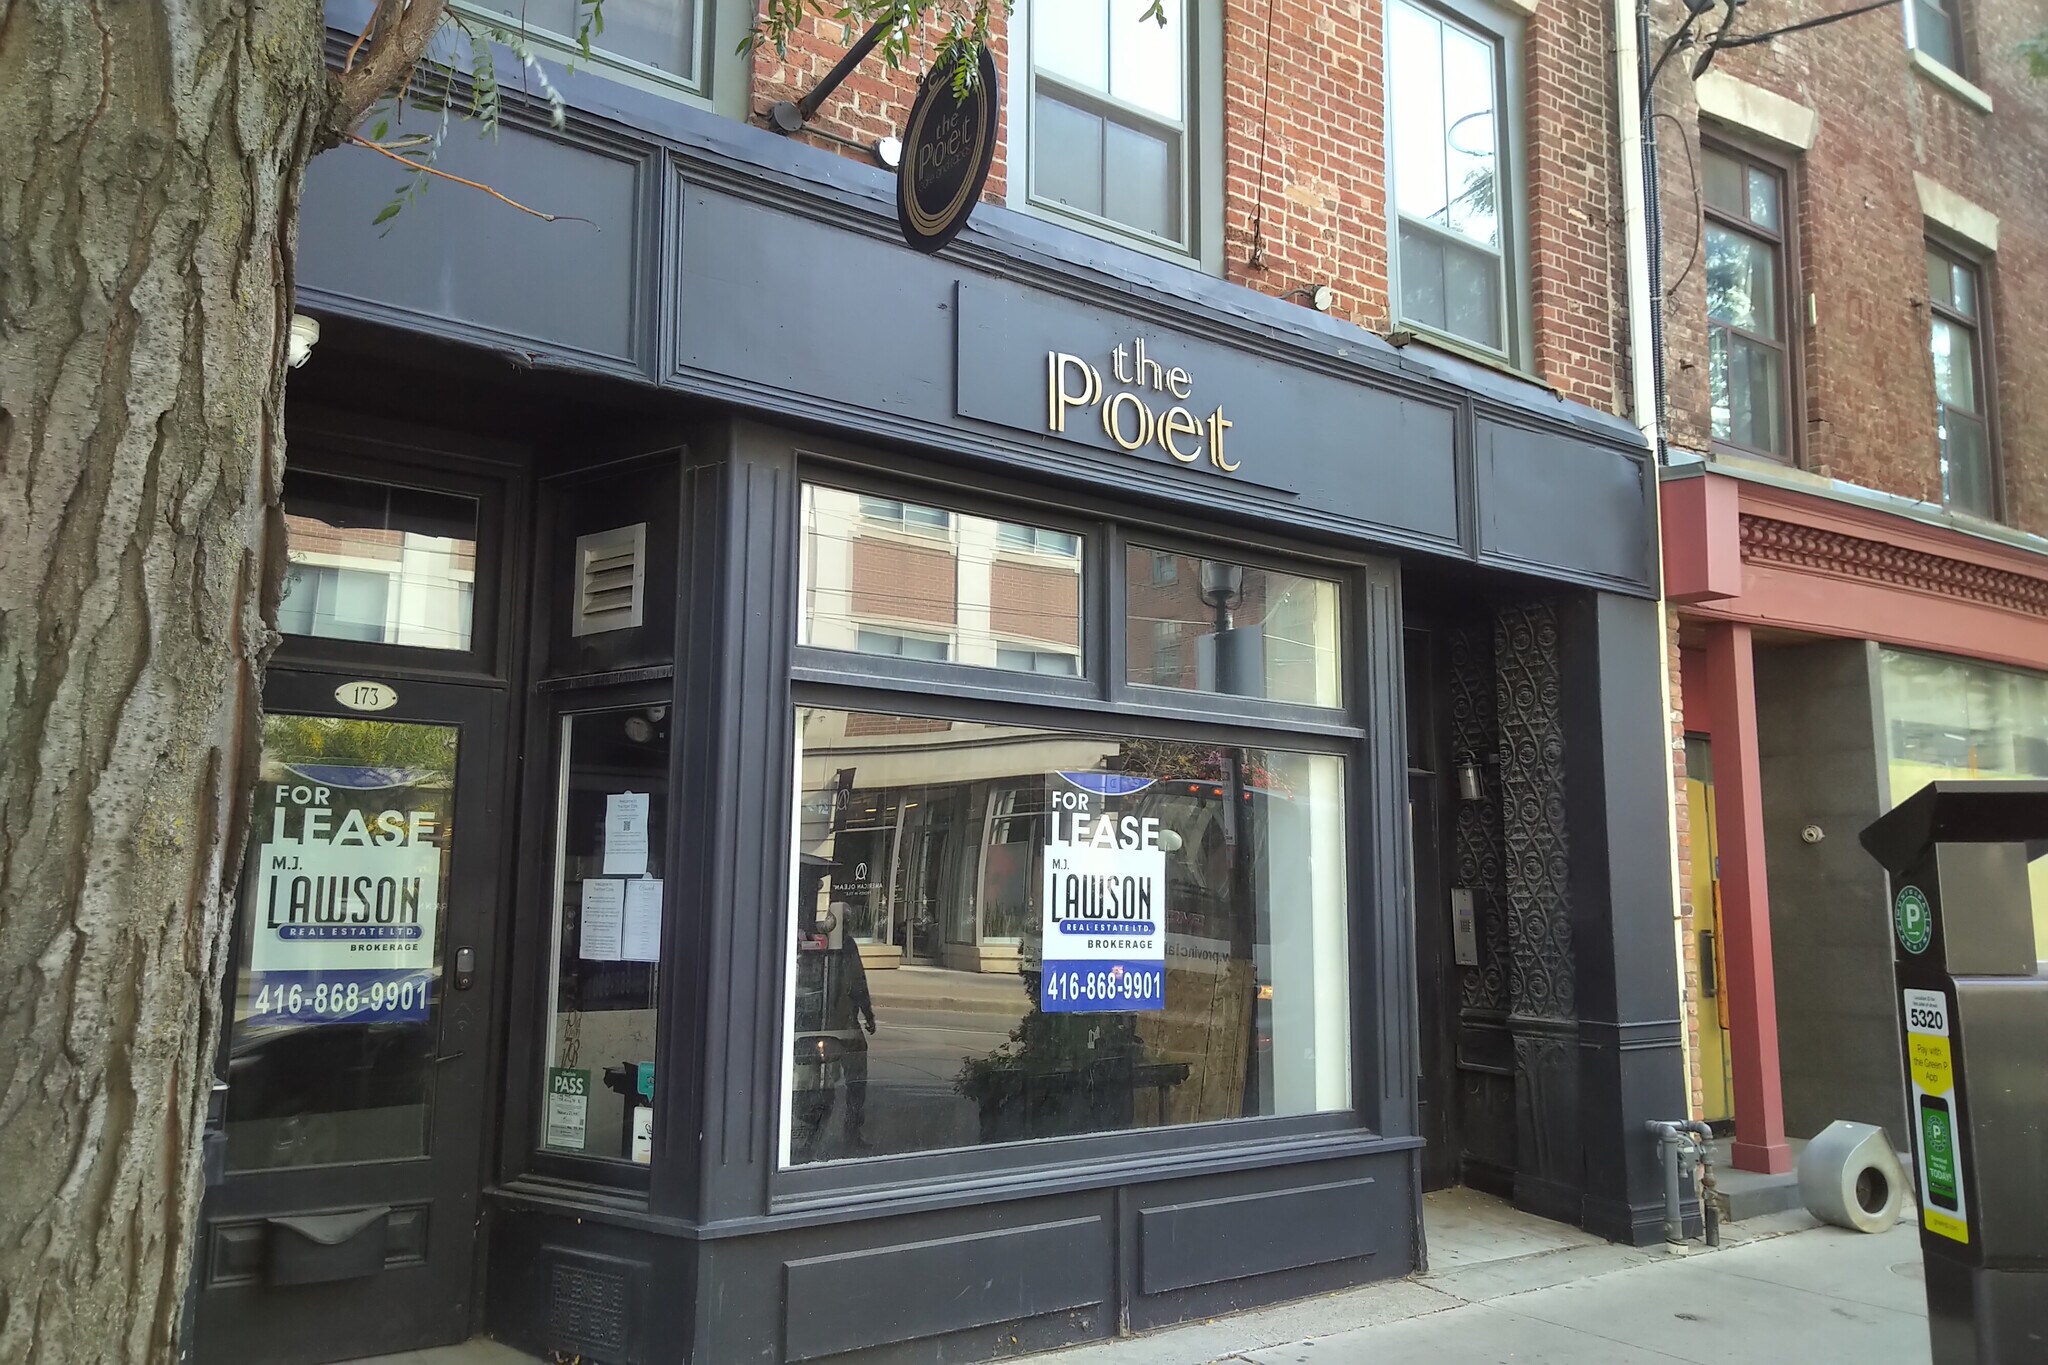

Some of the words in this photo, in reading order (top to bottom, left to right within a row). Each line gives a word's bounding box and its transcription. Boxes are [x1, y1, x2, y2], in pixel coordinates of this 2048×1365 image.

[935, 112, 959, 140] the
[1112, 336, 1193, 399] the
[354, 686, 379, 706] 173
[275, 784, 331, 805] FOR
[1051, 790, 1089, 811] FOR
[272, 806, 436, 848] LEASE
[1050, 811, 1160, 851] LEASE
[272, 855, 303, 870] M.J.
[1052, 858, 1070, 870] M.J.
[267, 875, 421, 929] LAWSON
[1051, 873, 1151, 923] LAWSON
[1906, 903, 1920, 929] P
[289, 928, 326, 937] REAL
[331, 927, 385, 936] ESTATE
[390, 928, 418, 937] LTD.
[1066, 923, 1092, 932] REAL
[1094, 923, 1129, 932] ESTATE
[350, 943, 419, 952] BROKERAGE
[1087, 939, 1153, 949] BROKERAGE
[1047, 971, 1161, 1000] 416-868-9901
[255, 981, 428, 1014] 416-868-9901
[1911, 1008, 1943, 1030] 5320
[1917, 1044, 1928, 1056] Pay
[1930, 1047, 1942, 1056] with
[1914, 1058, 1924, 1067] the
[1924, 1058, 1942, 1069] Green
[554, 1075, 584, 1095] PASS
[1926, 1072, 1938, 1083] App
[1932, 1124, 1941, 1139] P
